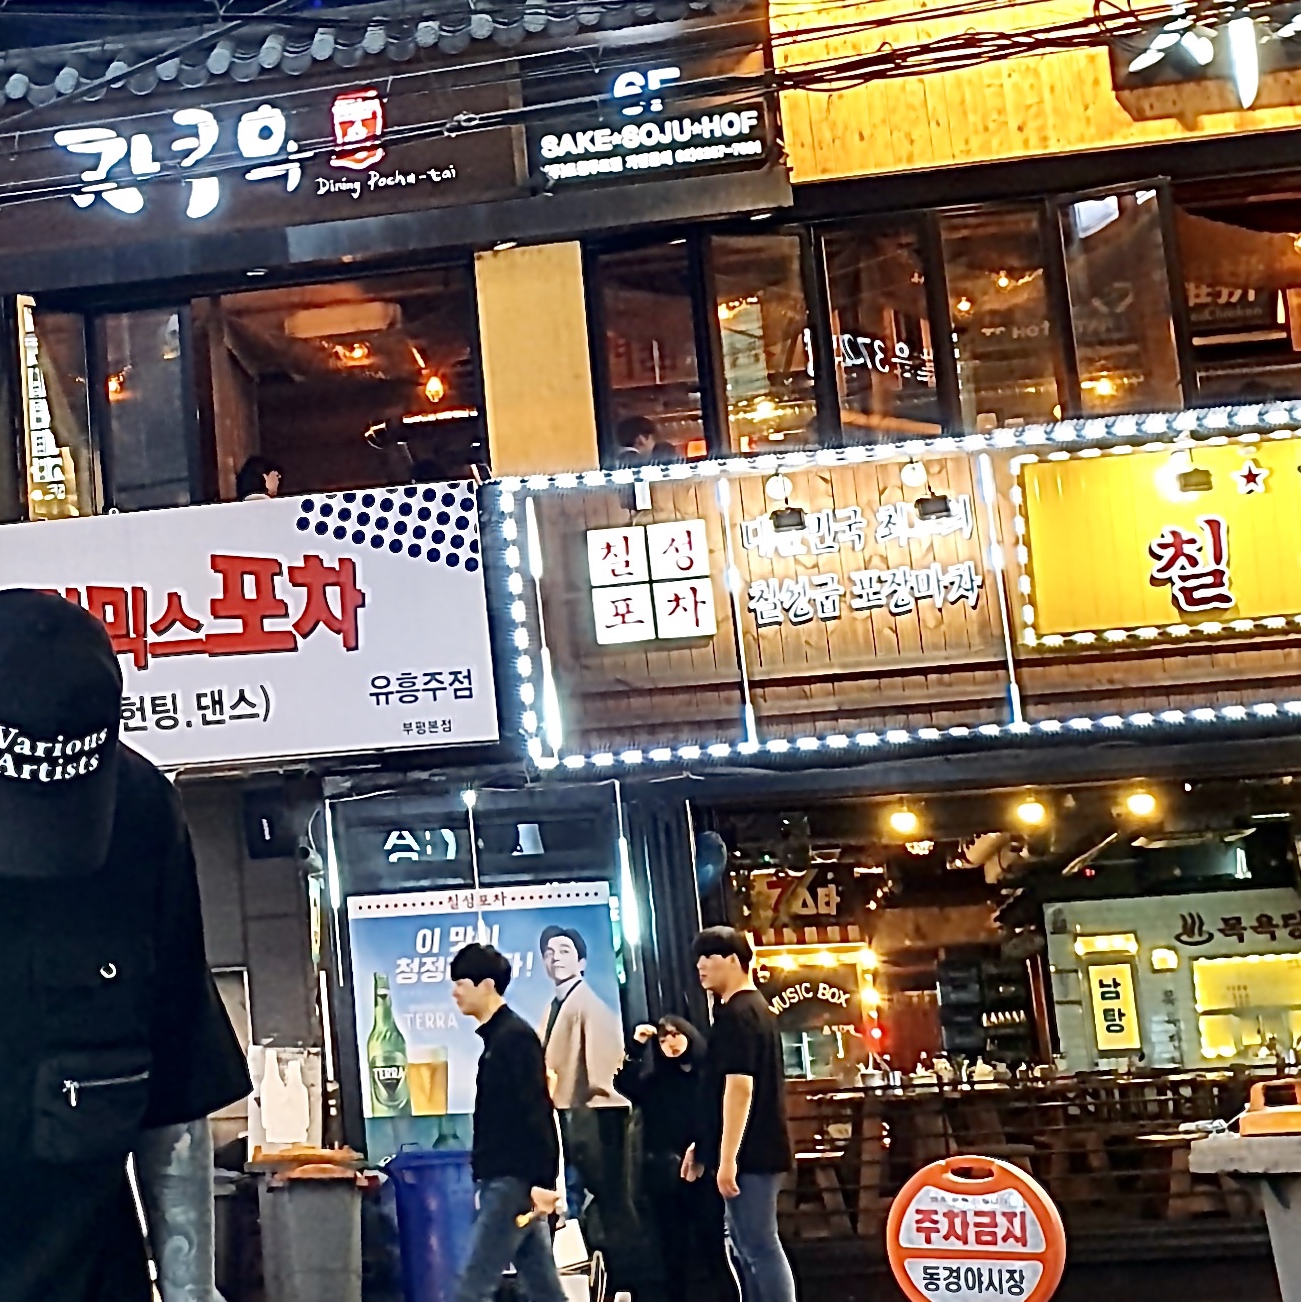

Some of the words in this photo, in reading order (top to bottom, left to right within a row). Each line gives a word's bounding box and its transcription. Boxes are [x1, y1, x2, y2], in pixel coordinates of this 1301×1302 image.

[315, 176, 361, 199] Dining
[1149, 515, 1237, 613] 칠
[850, 560, 983, 617] 포장마차
[369, 668, 475, 706] 유흥주점
[402, 719, 453, 736] 부평본점
[415, 927, 442, 954] 이
[767, 982, 815, 1017] MUSIC
[816, 982, 852, 1009] BOX
[1098, 977, 1126, 1035] 남탕
[403, 1011, 460, 1031] TERRA
[372, 1066, 405, 1080] TERRA
[915, 1208, 1028, 1248] 주차금지
[922, 1265, 1026, 1297] 동경야시장
